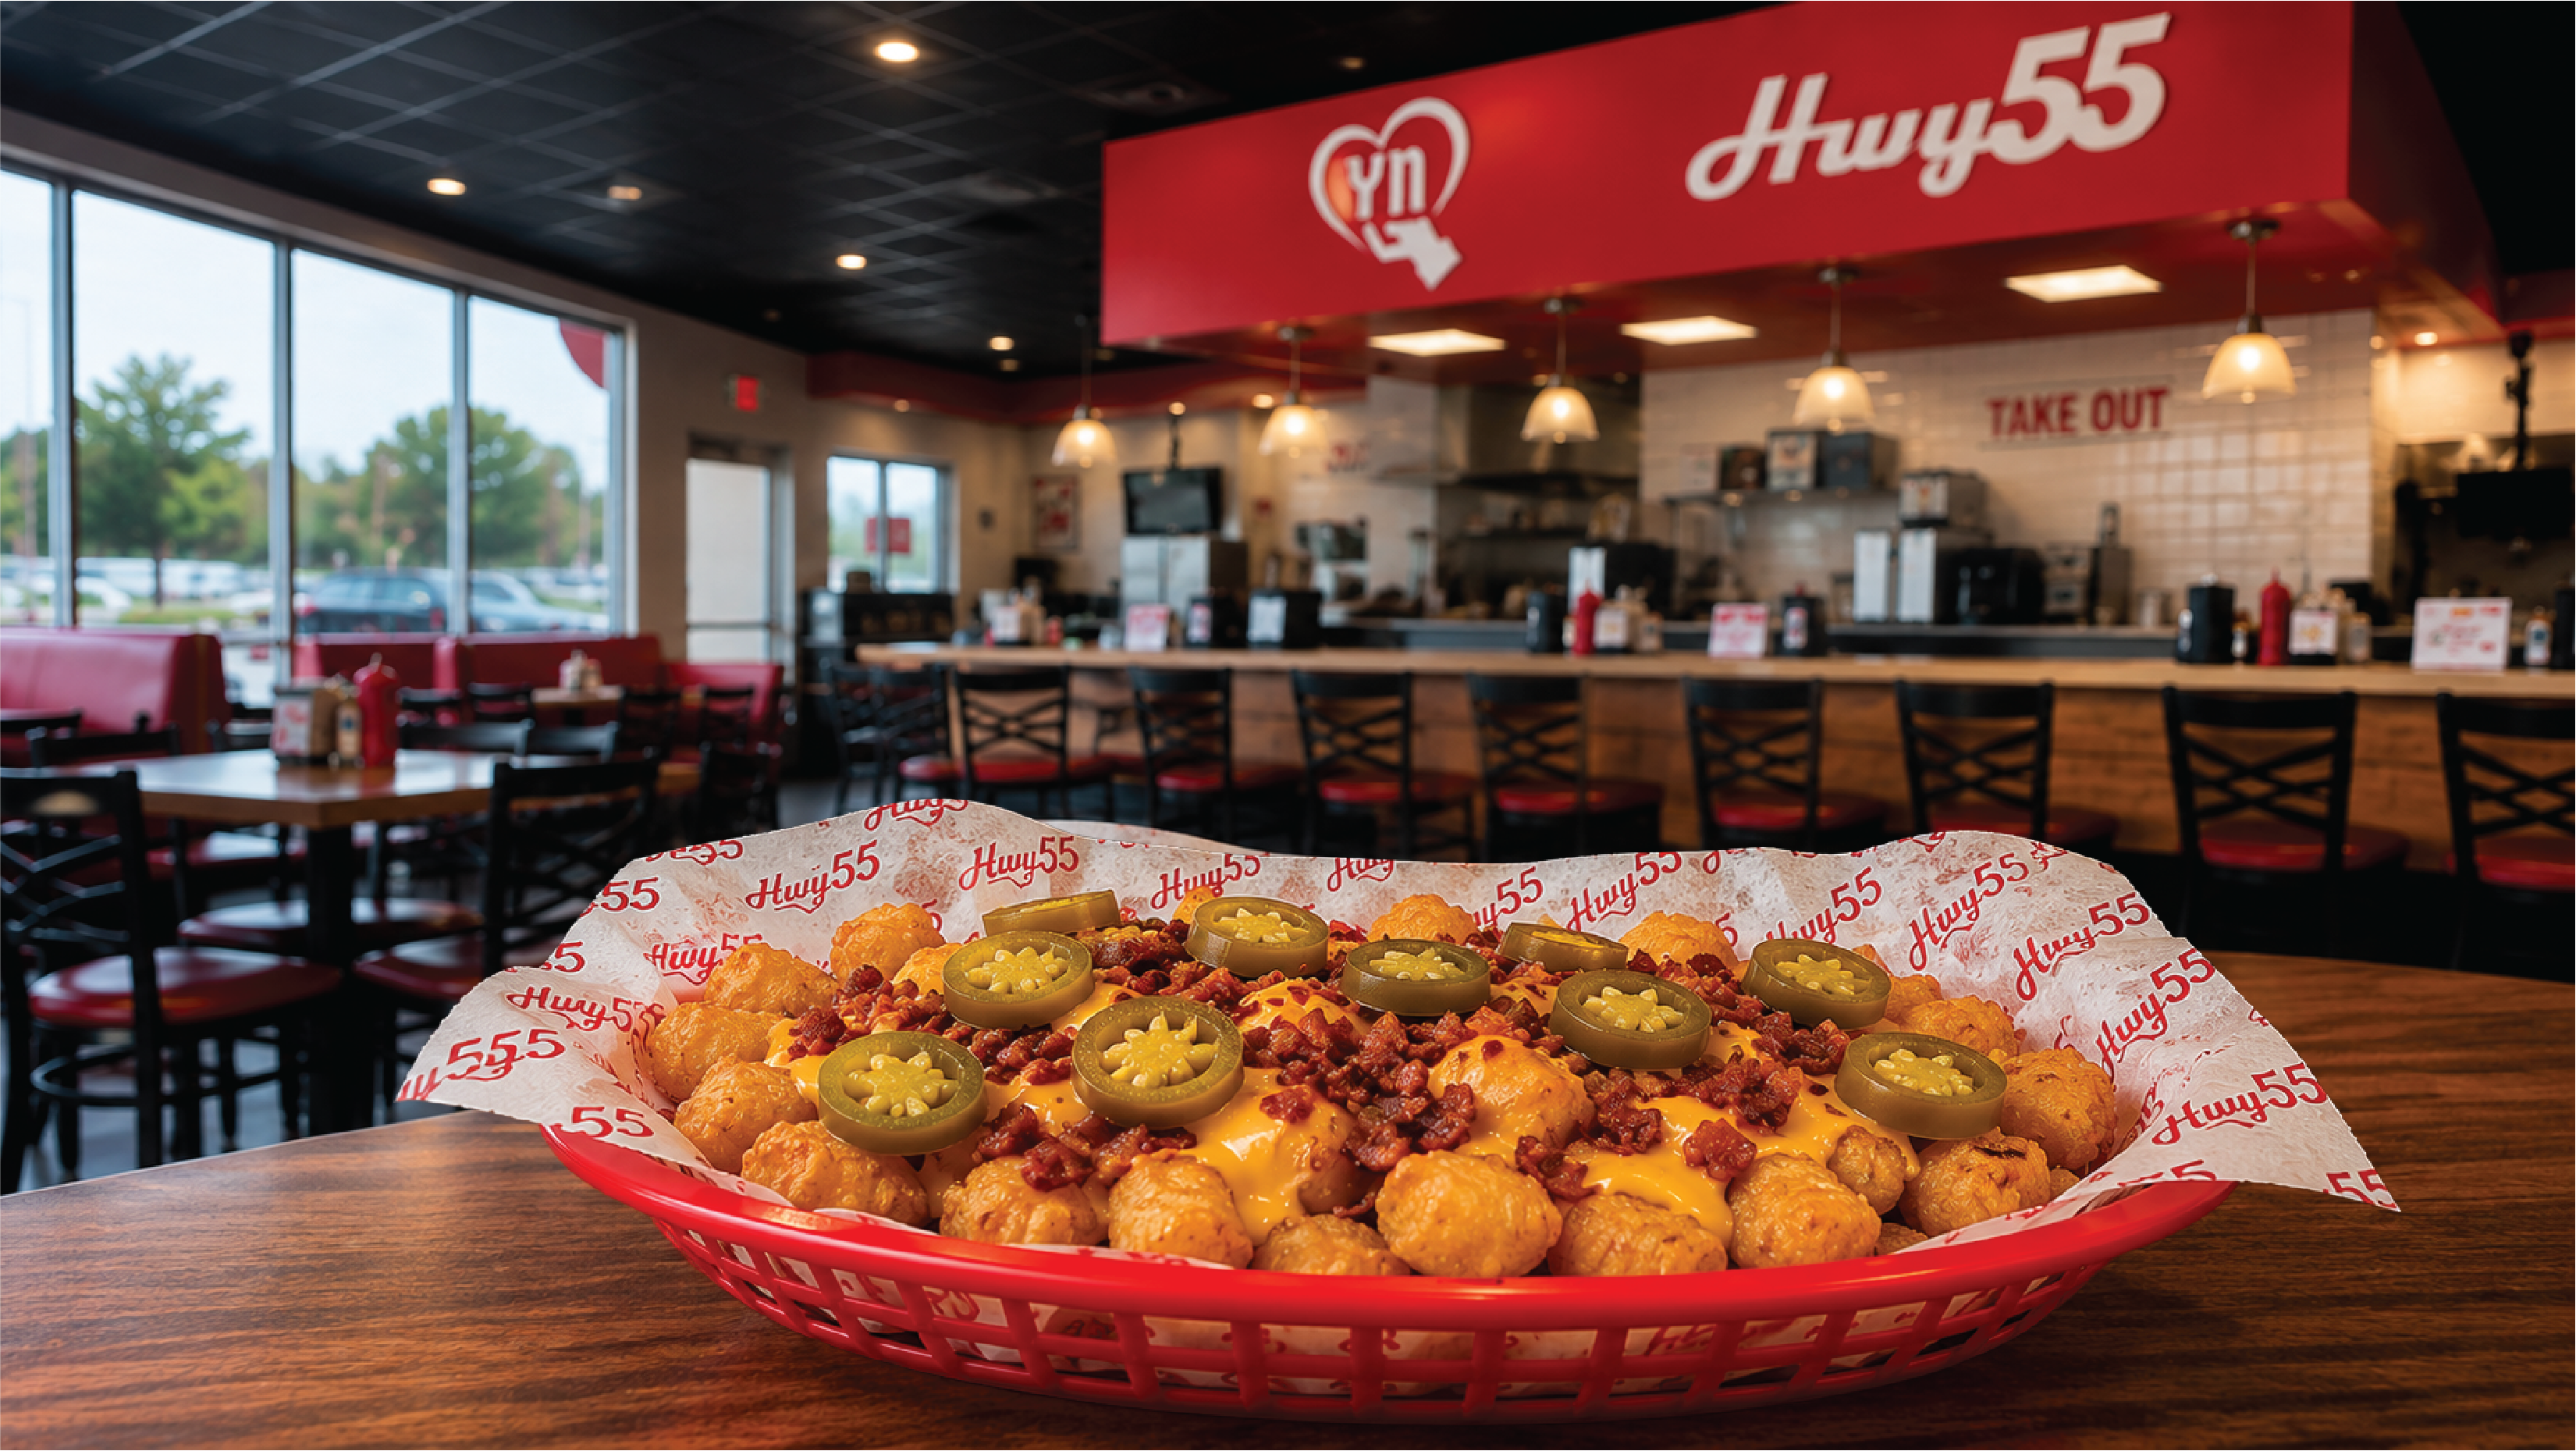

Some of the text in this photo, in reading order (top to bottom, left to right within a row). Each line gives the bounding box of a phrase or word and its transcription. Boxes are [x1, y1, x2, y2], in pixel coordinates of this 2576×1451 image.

[1685, 12, 2171, 201] Hwy55
[1984, 386, 2169, 437] TAKE OUT
[745, 840, 880, 915] Hwy55
[959, 835, 1080, 891] Hwy55
[1910, 852, 2029, 971] Hwy55
[2013, 892, 2150, 1001] Hwy55
[2151, 1063, 2327, 1145] Hwy55
